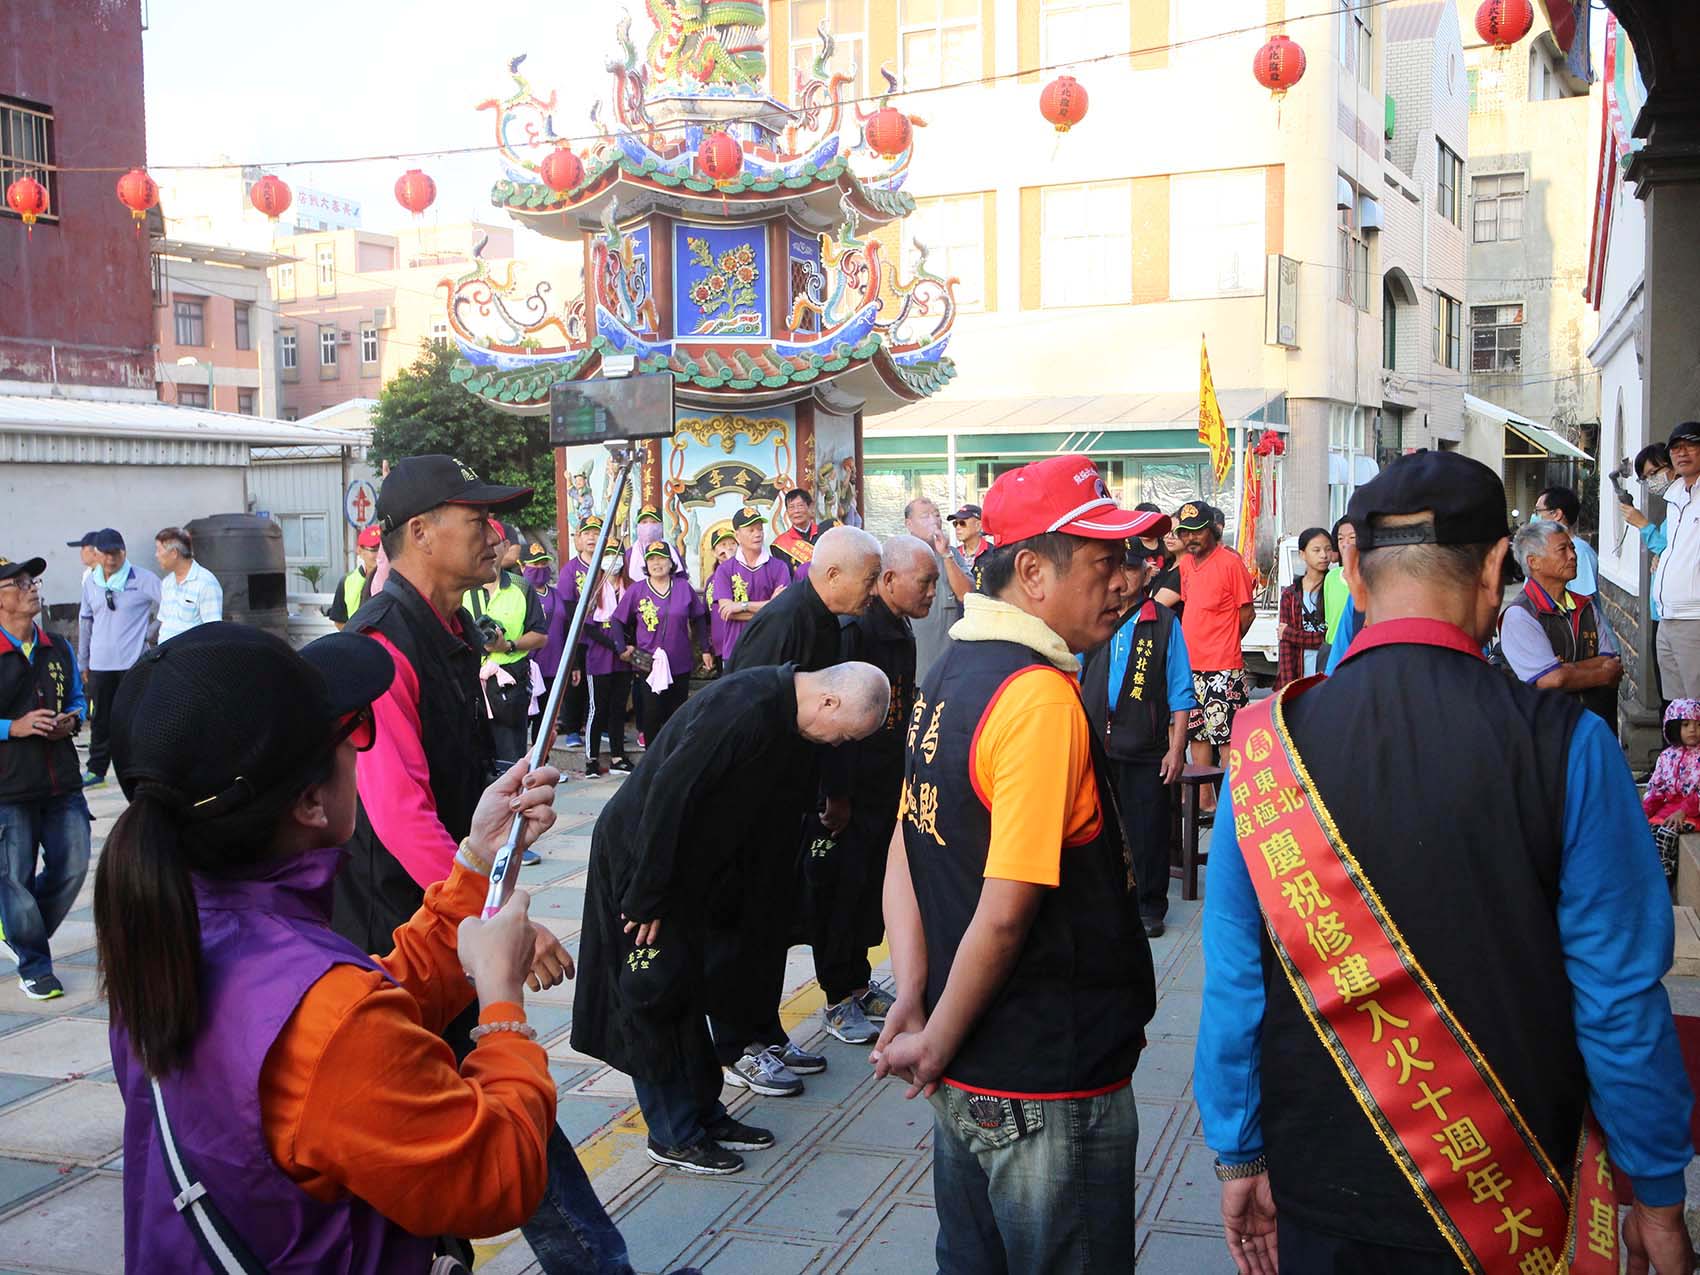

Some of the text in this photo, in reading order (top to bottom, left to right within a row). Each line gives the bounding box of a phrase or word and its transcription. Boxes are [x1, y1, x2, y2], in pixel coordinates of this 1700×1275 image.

[1130, 656, 1148, 701] 北極殿
[1235, 787, 1305, 841] 北極殿
